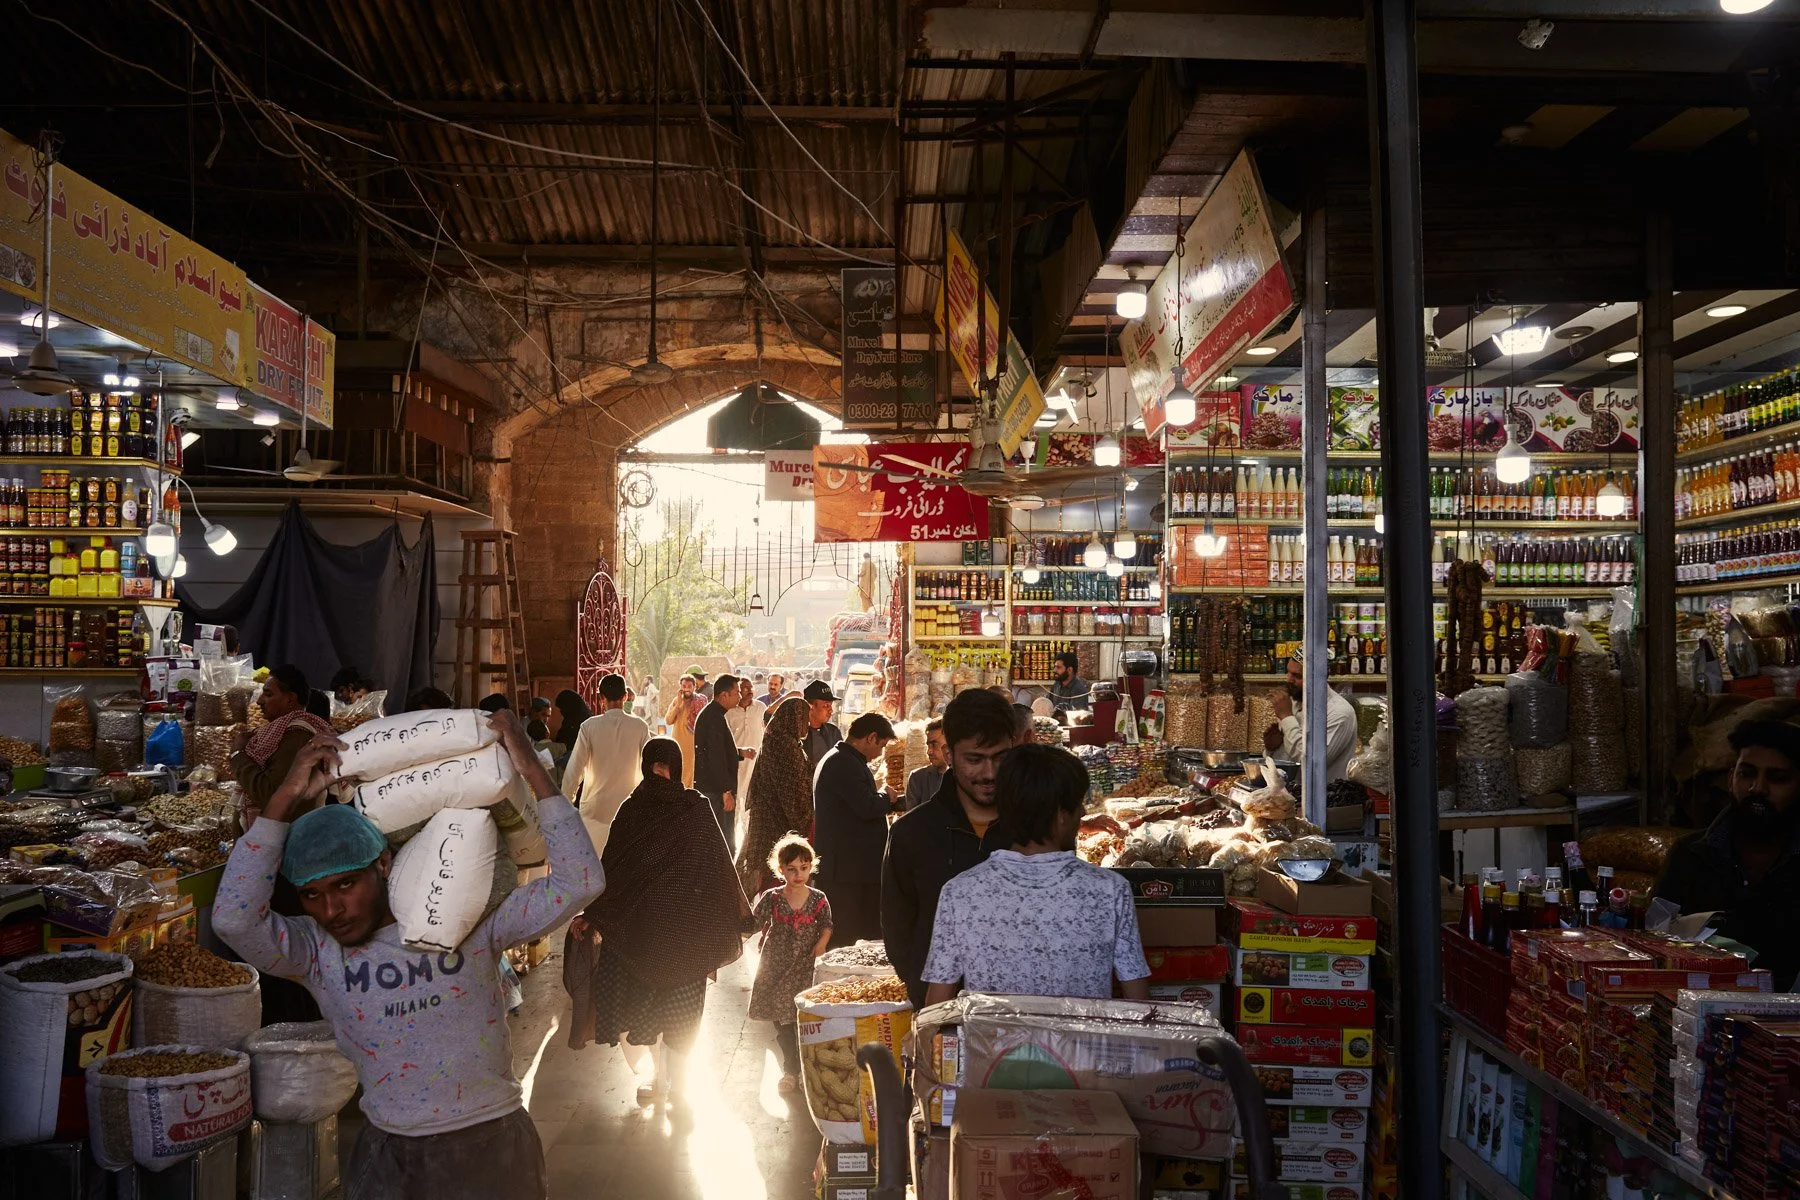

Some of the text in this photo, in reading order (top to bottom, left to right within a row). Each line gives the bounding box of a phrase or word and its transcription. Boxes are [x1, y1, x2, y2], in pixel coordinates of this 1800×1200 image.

[134, 228, 172, 274] آباد
[173, 255, 217, 298] اسلام
[217, 280, 243, 315] نیو
[256, 359, 285, 394] DRY
[857, 490, 944, 520] ڈرائی فروٹ
[953, 523, 978, 538] دکان
[344, 949, 465, 993] MOMO
[384, 994, 441, 1018] MILANO
[1301, 995, 1368, 1010] خرمای زاهدی
[184, 1112, 236, 1140] NATURAL
